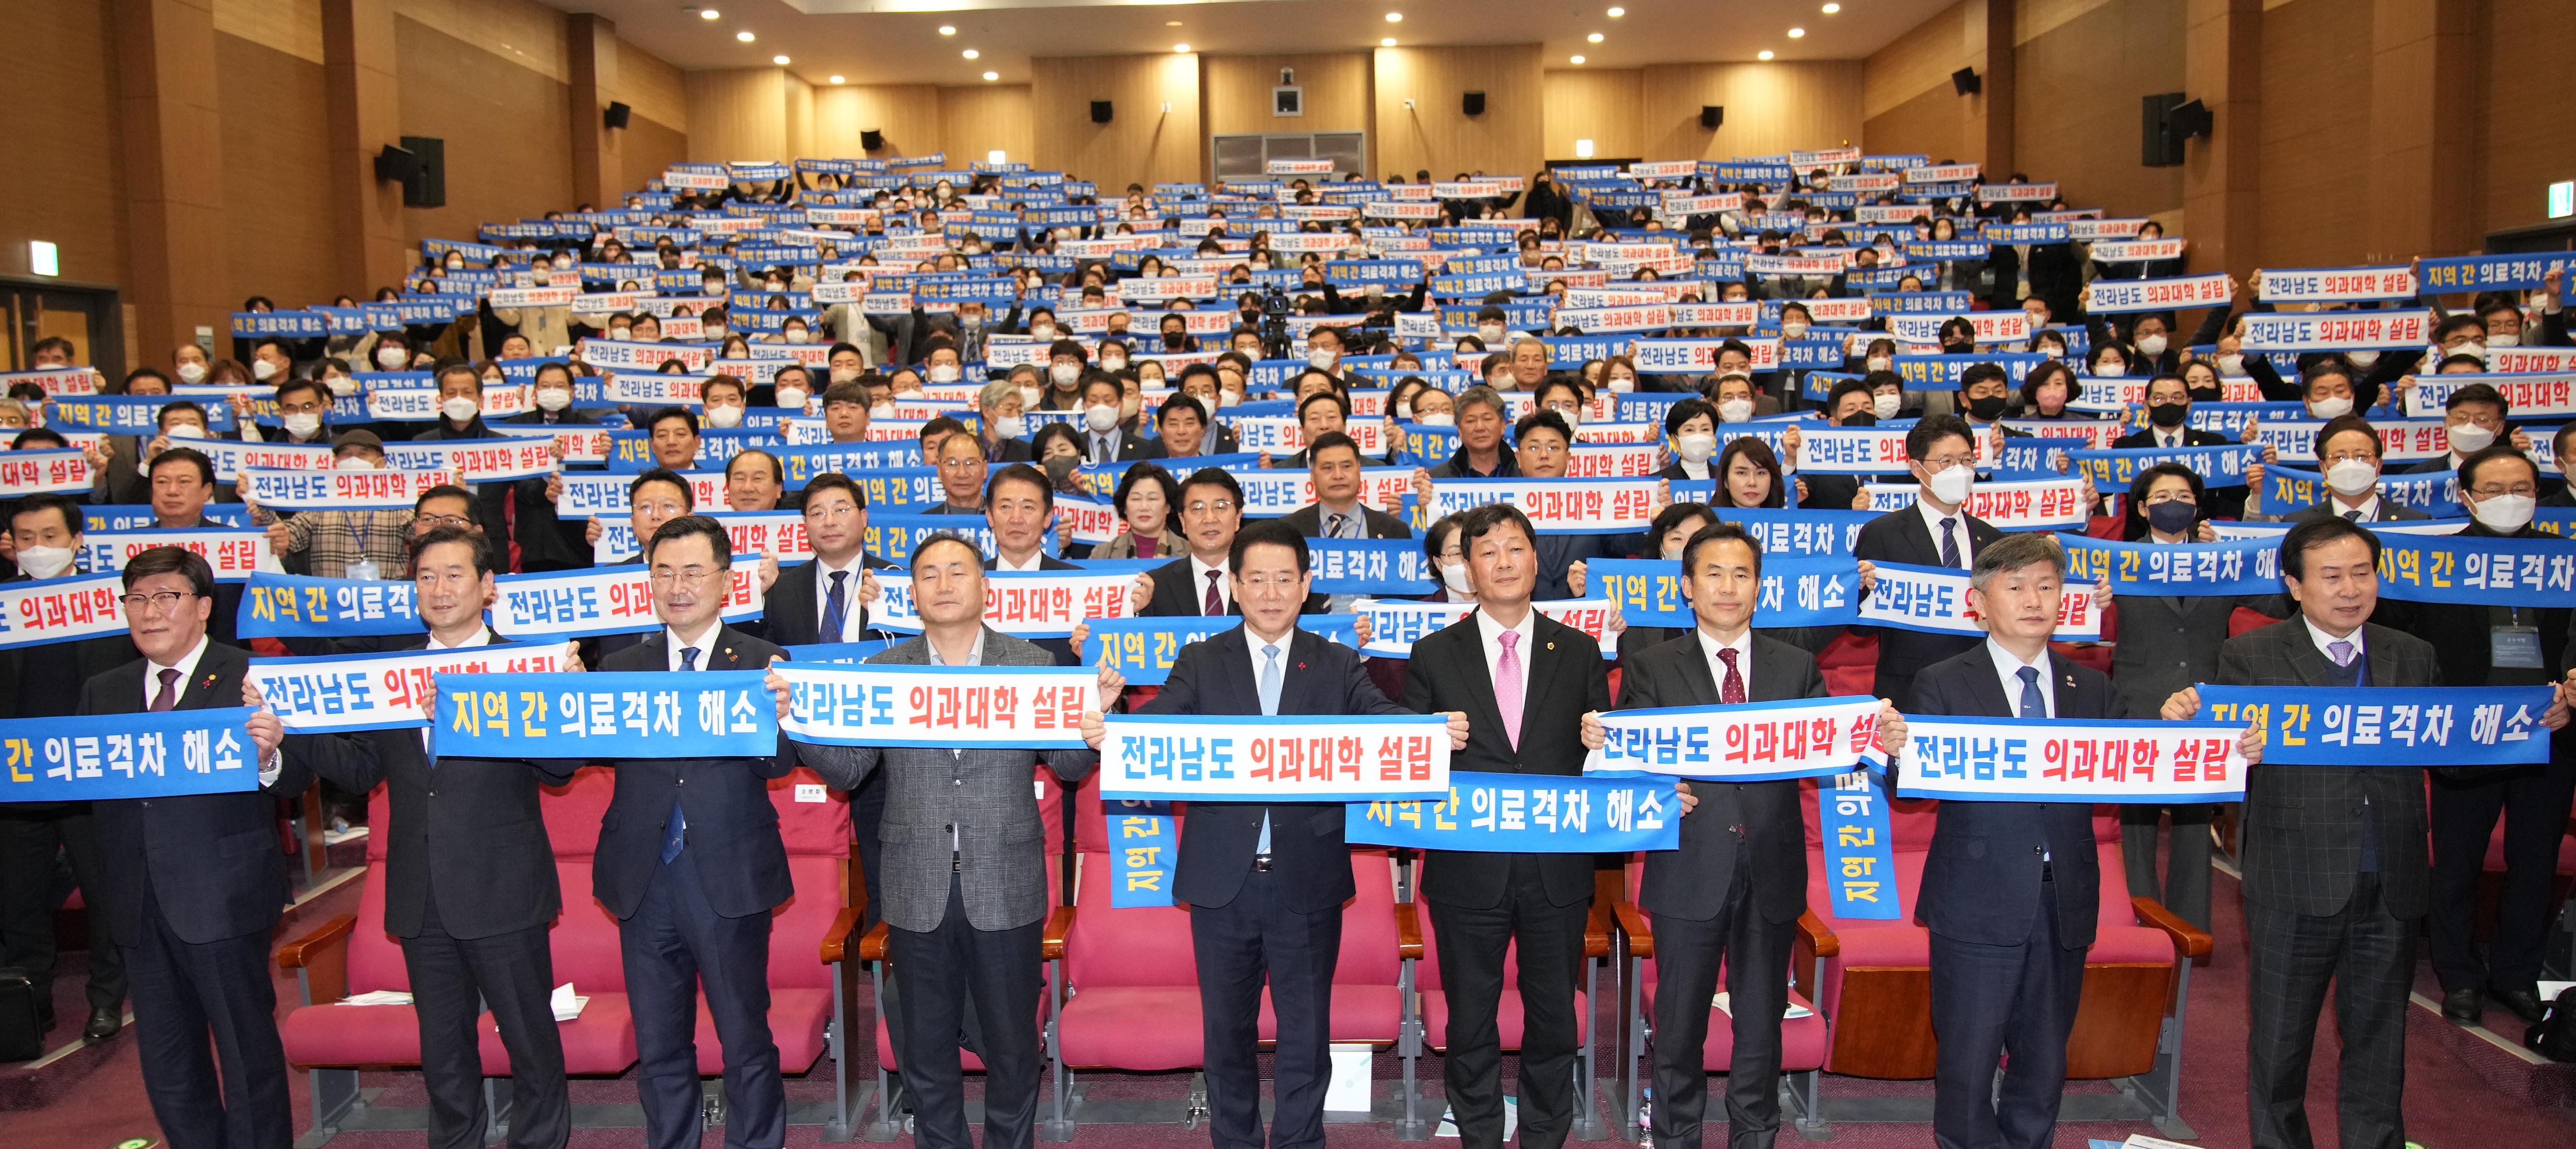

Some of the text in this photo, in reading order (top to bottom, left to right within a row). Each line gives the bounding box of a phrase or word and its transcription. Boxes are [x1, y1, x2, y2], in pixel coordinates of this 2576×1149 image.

[1331, 266, 1419, 279] 지역 간 의료격차 해소
[2270, 274, 2408, 295] 전라남도 의과대학 설립
[2429, 261, 2541, 285] 지역 간 의료격차
[920, 283, 1014, 298] 지역 간 의료격차 해소
[1125, 278, 1211, 296] 전라남도 의과대학 설립
[2095, 281, 2223, 306] 전라남도 의과대학 설립
[1698, 308, 1751, 321] 의과대학 설립
[1815, 304, 1865, 316] 의과대학 설립
[1872, 297, 1964, 311] 지역 간 의료격차 해소
[733, 314, 760, 328] 지역 간
[1402, 319, 1434, 333] 전라남도
[1562, 310, 1665, 329] 전라남도 의과대학 설립
[2001, 318, 2022, 336] 설립
[2252, 318, 2420, 344] 전라남도 의과대학 설립
[590, 346, 630, 363] 전라남도
[994, 348, 1030, 363] 전라남도
[1559, 343, 1607, 362] 의료격차
[1642, 345, 1771, 366] 전라남도 설립
[1818, 346, 1838, 362] 해소
[66, 374, 90, 392] 설립
[1900, 362, 1944, 382] 지역 간
[621, 380, 663, 398] 전라남도
[58, 404, 111, 425] 지역 간
[380, 392, 515, 413] 전라남도 설립
[1349, 426, 1376, 448] 설립
[453, 449, 513, 472] 의과대학
[521, 447, 549, 469] 설립
[618, 439, 649, 461] 지역
[1809, 439, 1871, 463] 전라남도
[50, 460, 86, 484] 설립
[791, 456, 805, 480] 간
[1622, 454, 1650, 476] 설립
[2077, 449, 2261, 485] 지역 간 해소
[257, 476, 327, 499] 전라남도
[337, 474, 406, 498] 의과대학
[2276, 477, 2313, 505] 지역
[1527, 491, 1649, 520] 의과대학 설립
[2041, 489, 2075, 517] 설립
[889, 528, 907, 557] 간
[1751, 522, 1834, 554] 의료격차
[219, 541, 256, 569] 설립
[1309, 551, 1388, 581] 의료격차
[2120, 551, 2141, 581] 간
[2149, 550, 2242, 583] 의료격차
[2256, 548, 2276, 579] 해
[2375, 548, 2574, 591] 지역 간 의료격차
[251, 584, 419, 621] 지역 간 의료격
[509, 587, 599, 624] 전라남도
[985, 586, 1125, 622] 의과대학 설립
[1603, 575, 1844, 611] 지역 간 해소
[1874, 578, 1953, 617] 전라남도
[21, 588, 116, 630] 의과대학
[1099, 632, 1176, 669] 지역 간
[263, 673, 374, 716] 전라남도
[790, 682, 1084, 728] 전라남도 의과대학 설립
[453, 690, 757, 737] 지역 간 의료격차 해소
[2282, 704, 2532, 746] 간 의료격차 해소
[1604, 727, 1709, 764] 전라남도
[1726, 718, 1836, 764] 의과대학
[5, 728, 242, 782] 간 의료격차 해소
[1122, 736, 1431, 781] 전라남도 의과대학 설립
[1914, 736, 2230, 782] 전라남도 의과대학 설립
[1435, 787, 1459, 830] 간
[1472, 788, 1590, 833] 의료격차
[1607, 790, 1663, 832] 해소
[1835, 772, 1879, 902] 지역 간 의료
[1123, 817, 1163, 890] 지역 간
